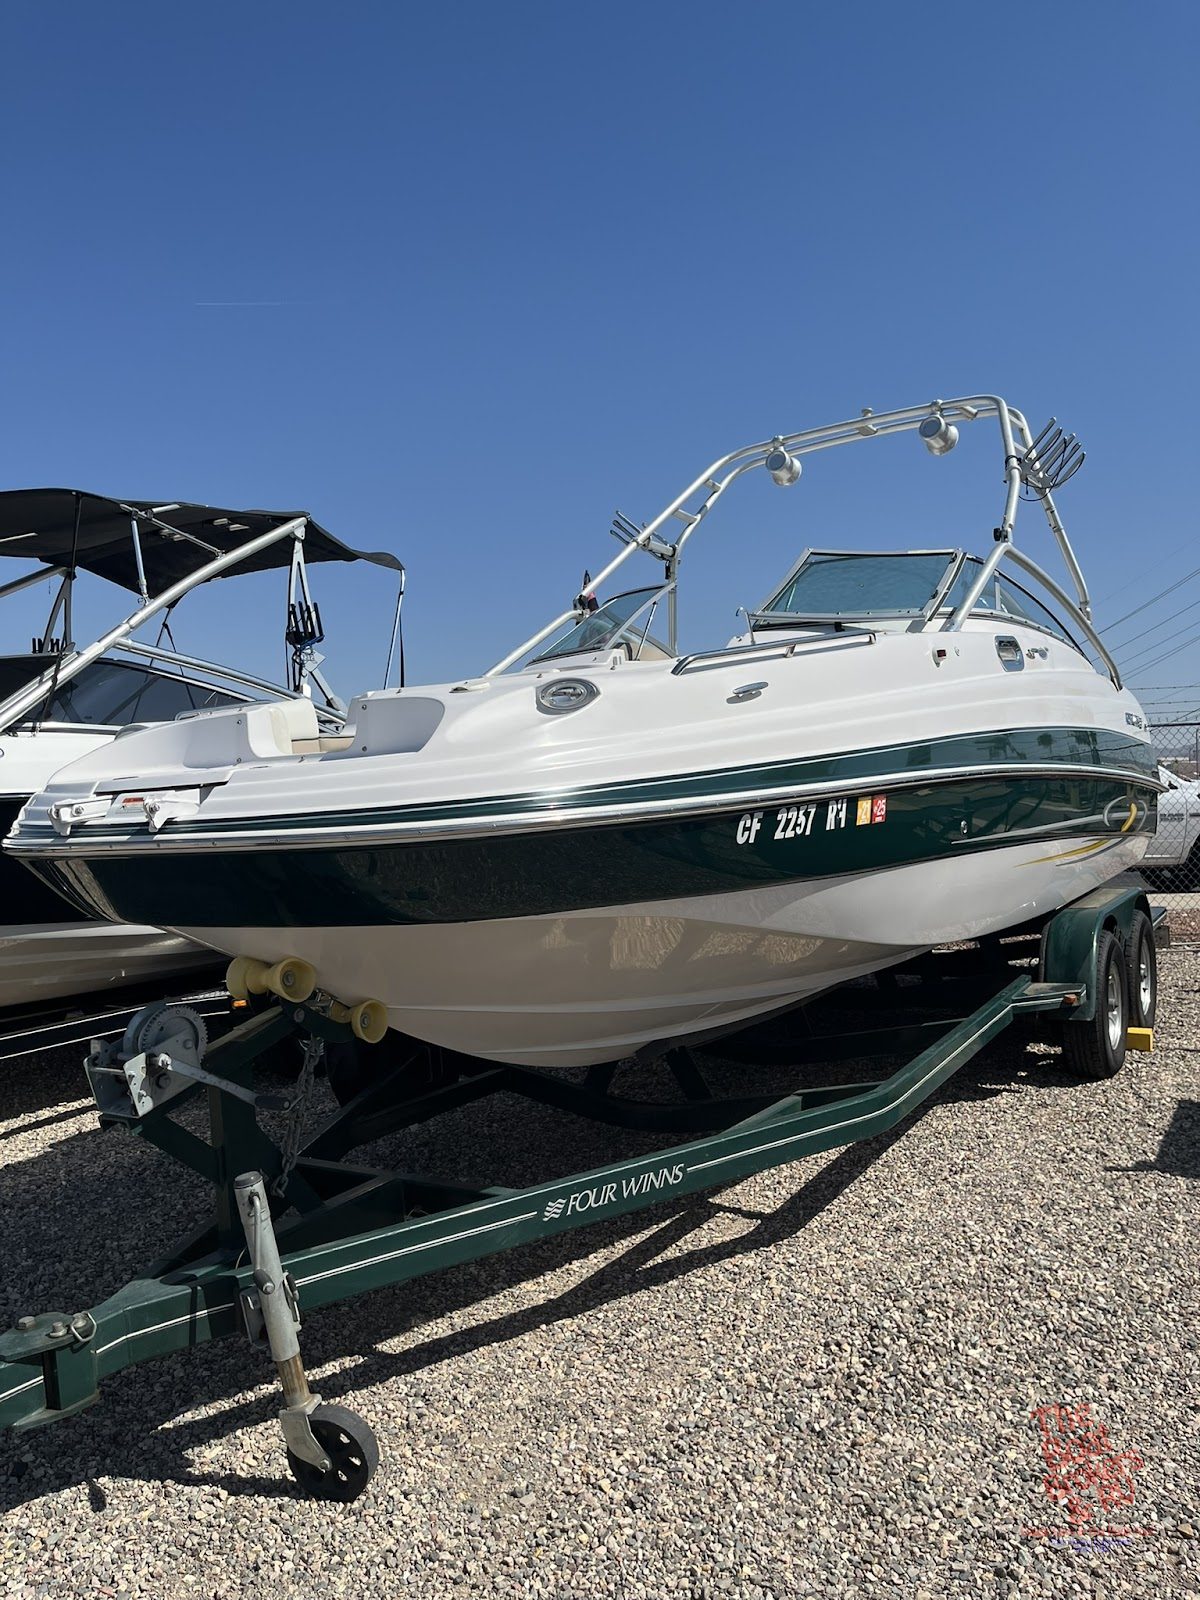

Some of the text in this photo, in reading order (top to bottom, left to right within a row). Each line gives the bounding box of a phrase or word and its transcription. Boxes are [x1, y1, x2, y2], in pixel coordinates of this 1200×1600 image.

[736, 812, 763, 844] CF
[774, 804, 816, 840] 2257
[566, 1163, 684, 1216] FOUR WINNS
